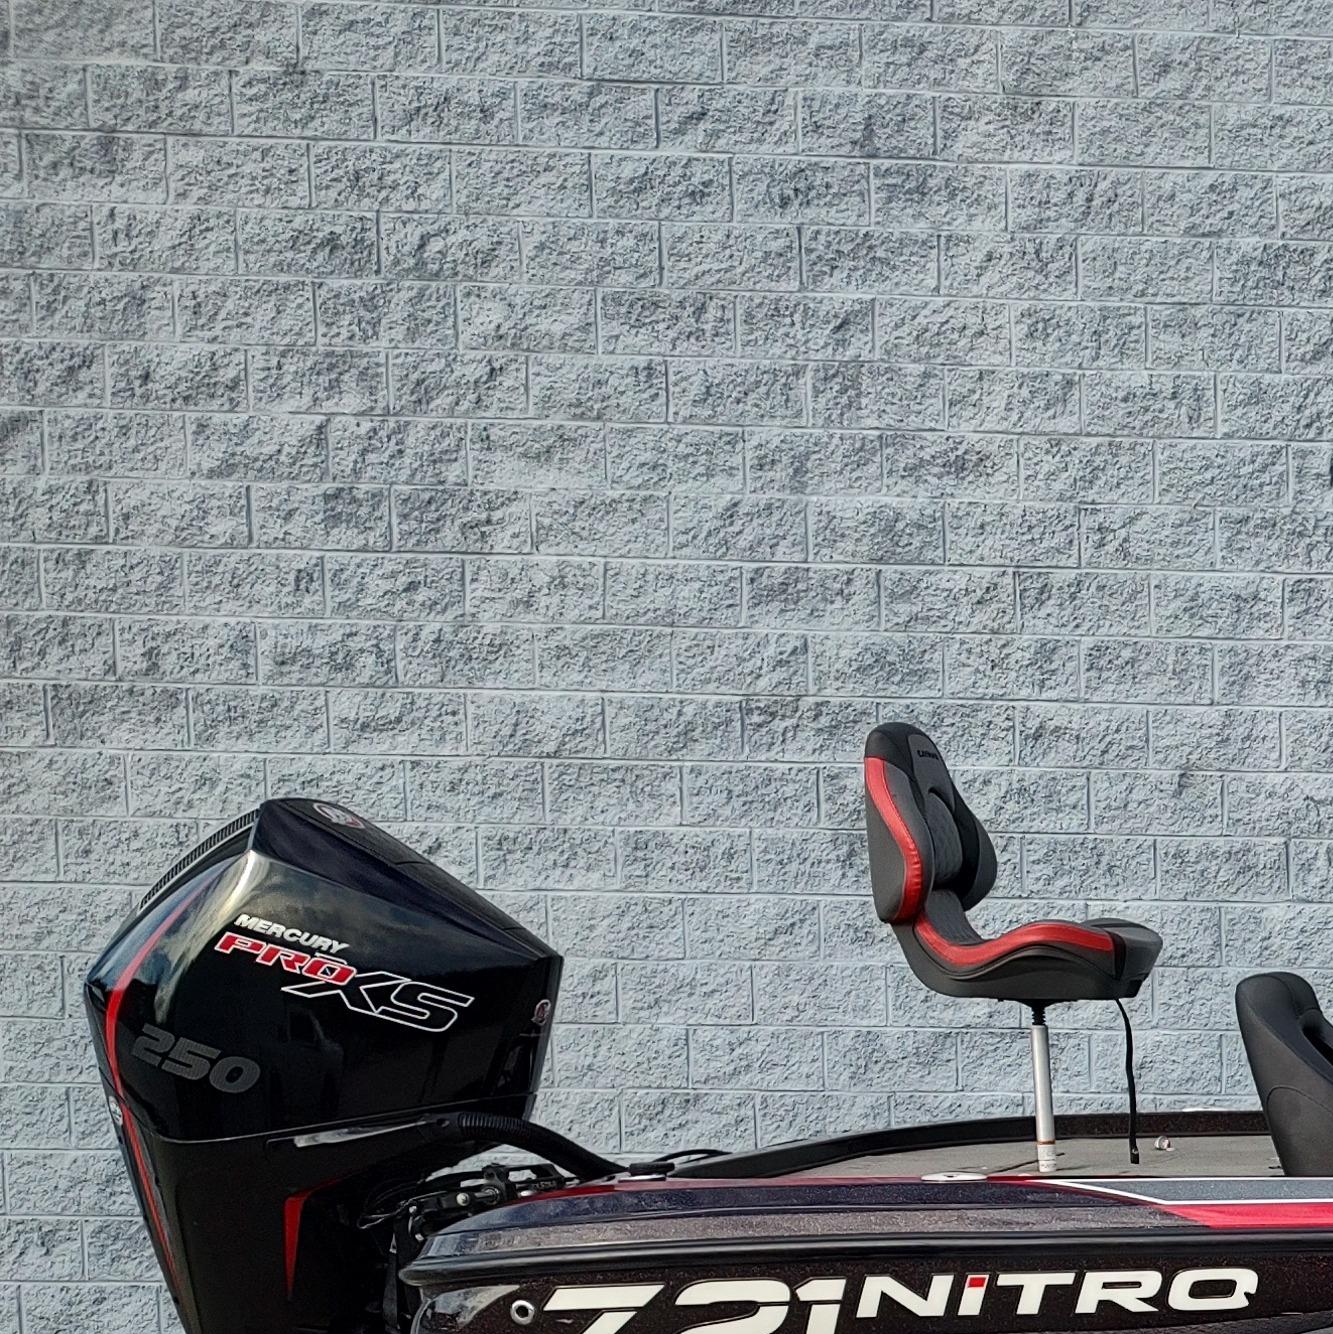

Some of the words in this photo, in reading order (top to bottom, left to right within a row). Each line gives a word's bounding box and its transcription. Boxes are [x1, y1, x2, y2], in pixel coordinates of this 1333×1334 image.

[214, 932, 357, 985] PRO
[234, 914, 350, 954] MERCURY
[281, 971, 475, 1032] XS
[131, 1023, 261, 1093] 250
